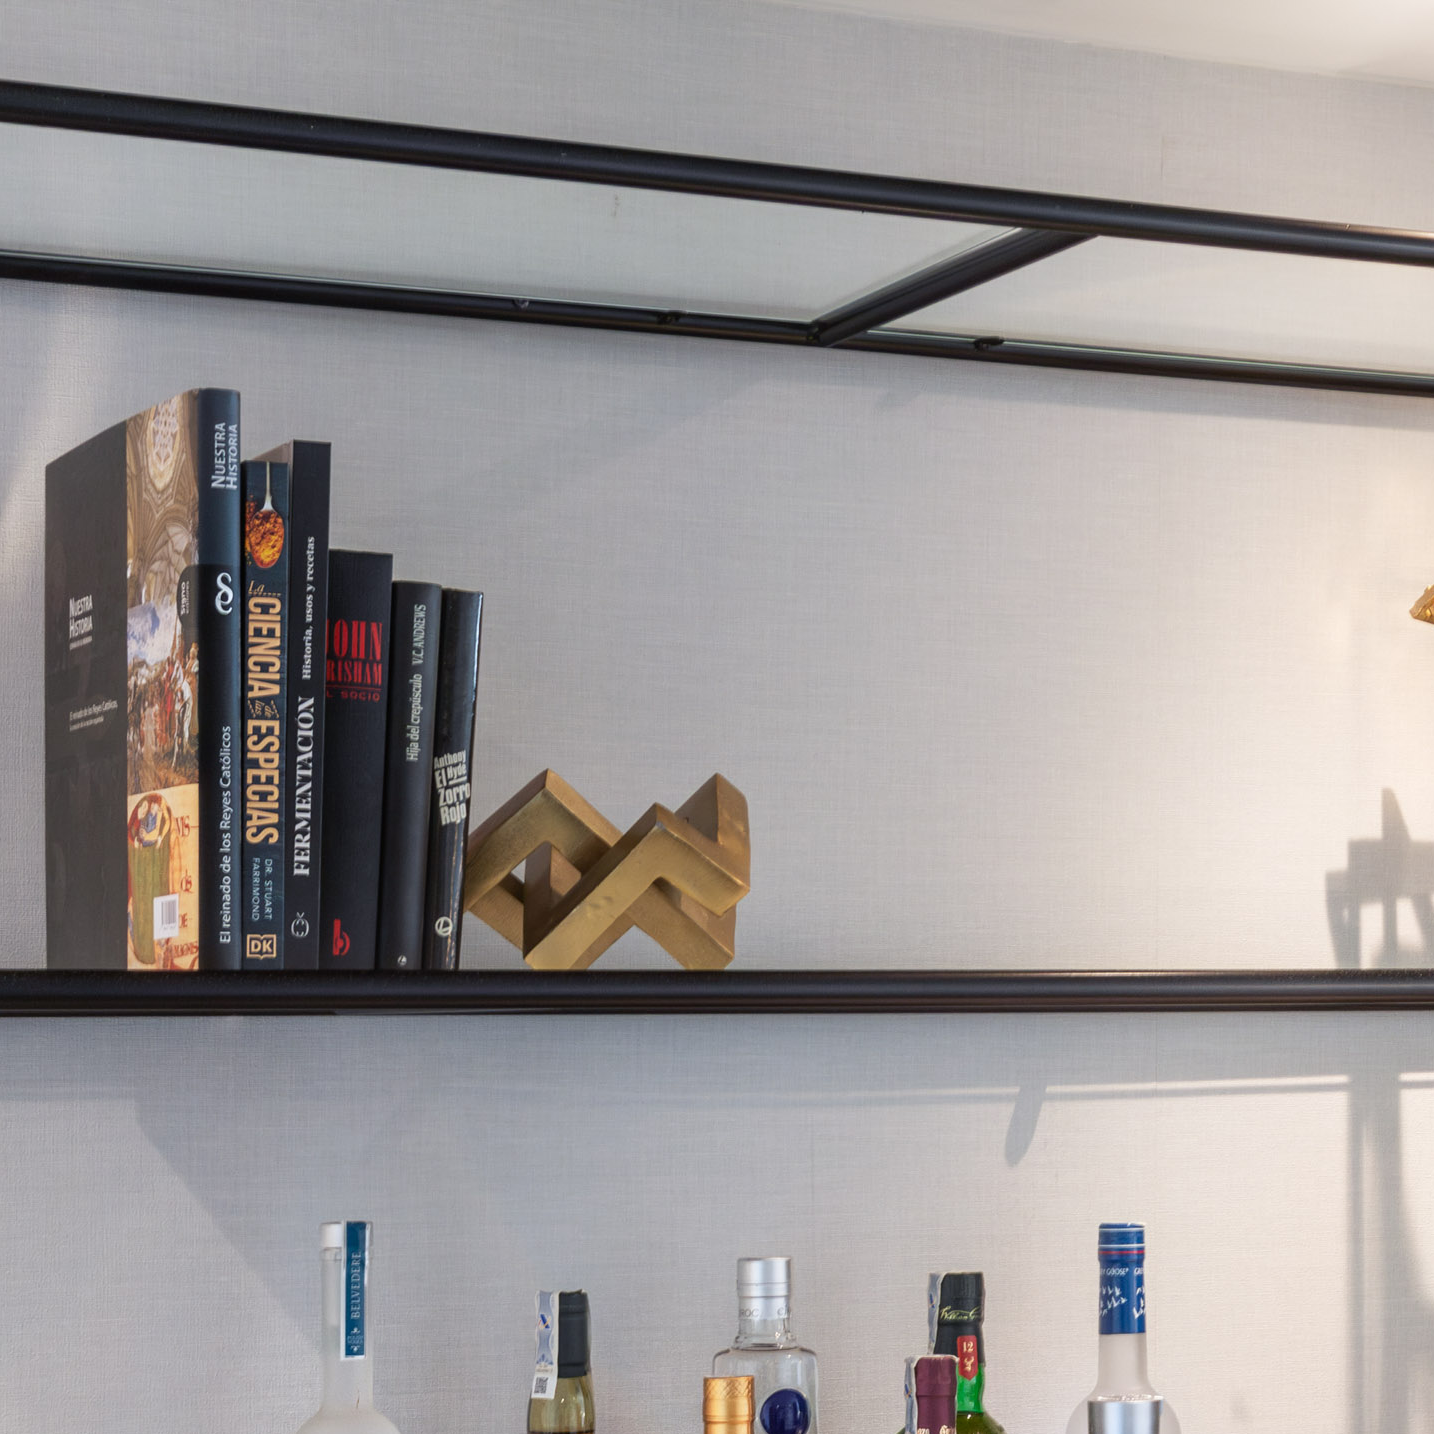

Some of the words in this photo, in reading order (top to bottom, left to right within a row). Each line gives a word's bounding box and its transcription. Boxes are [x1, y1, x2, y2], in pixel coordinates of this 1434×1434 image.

[210, 422, 227, 489] NUESTRA
[225, 423, 238, 490] HISTORIA
[306, 535, 316, 581] recetas
[248, 579, 265, 594] La
[305, 592, 314, 624] usos
[411, 603, 427, 649] ANDREWS
[247, 596, 282, 699] CIENCIA
[301, 624, 314, 681] Historia,
[325, 659, 383, 686] RISHAM
[340, 689, 382, 702] SOCIO
[409, 672, 424, 725] crepúsculo
[407, 724, 421, 741] del
[219, 725, 232, 788] Católicos
[406, 740, 420, 763] Hija
[434, 750, 467, 769] Anthony
[245, 719, 280, 845] ESPECIAS
[292, 695, 316, 877] FERMENTACIÓN
[435, 769, 447, 789] El
[447, 763, 468, 781] Hyde
[219, 790, 234, 829] Reyes
[437, 781, 471, 808] Zorro
[439, 801, 468, 827] Rojo
[219, 831, 232, 853] los
[219, 855, 232, 873] de
[219, 875, 232, 928] reinado
[251, 857, 261, 922] FARRIMOND
[264, 879, 273, 920] STUART
[219, 930, 232, 944] El
[350, 1251, 362, 1320] BELVEDERE
[962, 1341, 974, 1353] 12
